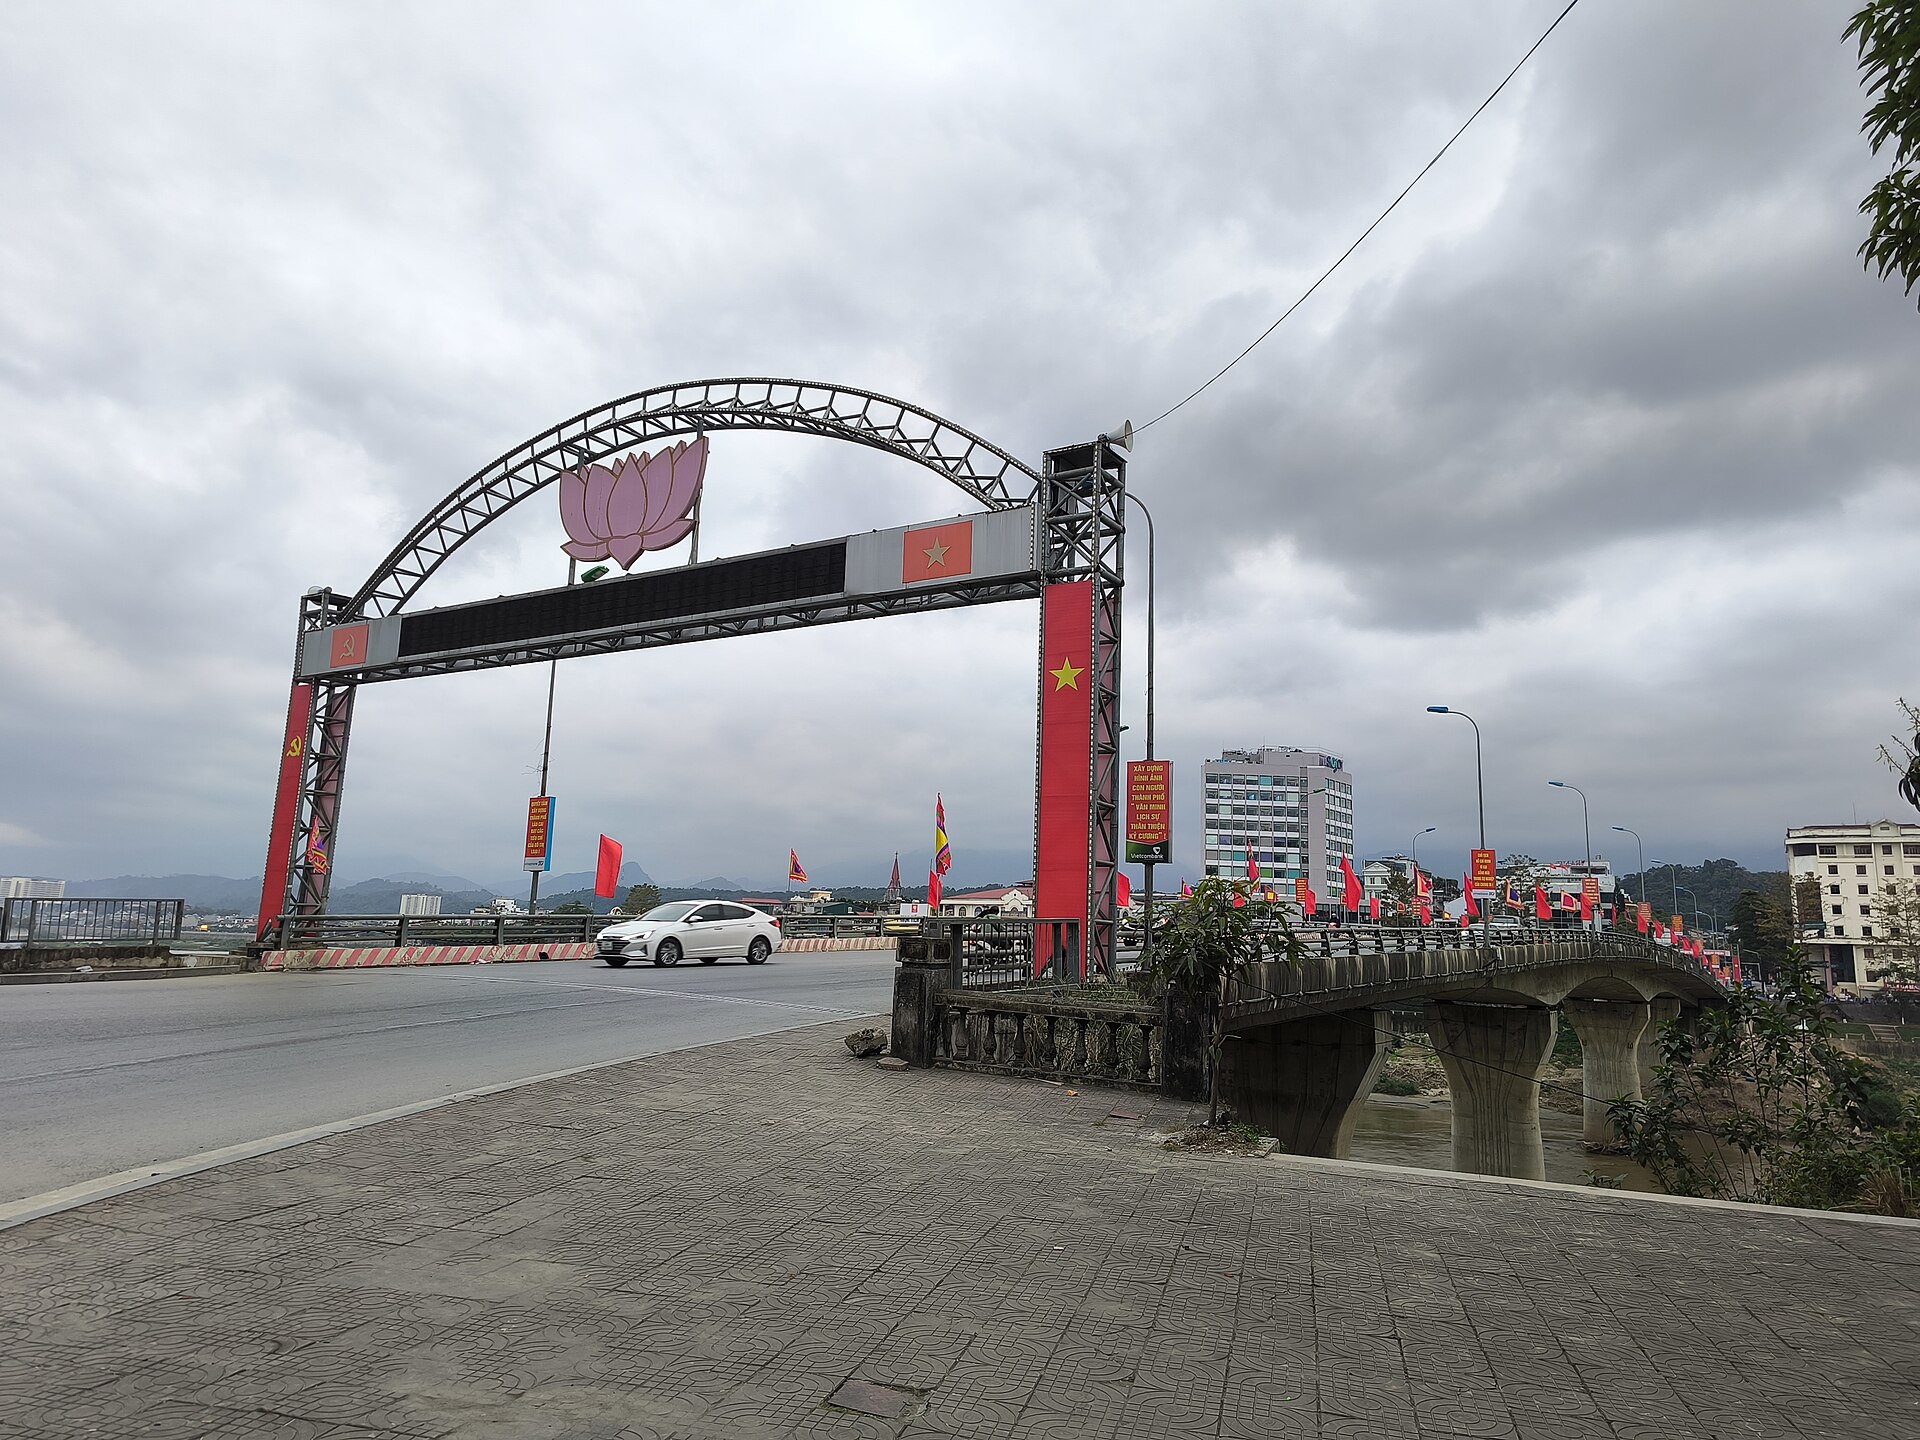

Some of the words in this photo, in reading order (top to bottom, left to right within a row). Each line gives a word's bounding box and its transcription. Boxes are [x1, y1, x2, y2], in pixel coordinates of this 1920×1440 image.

[1134, 764, 1146, 772] XÂY
[1152, 792, 1165, 801] PHỐ
[1137, 813, 1150, 821] LỊCH
[1131, 822, 1147, 830] THÂN
